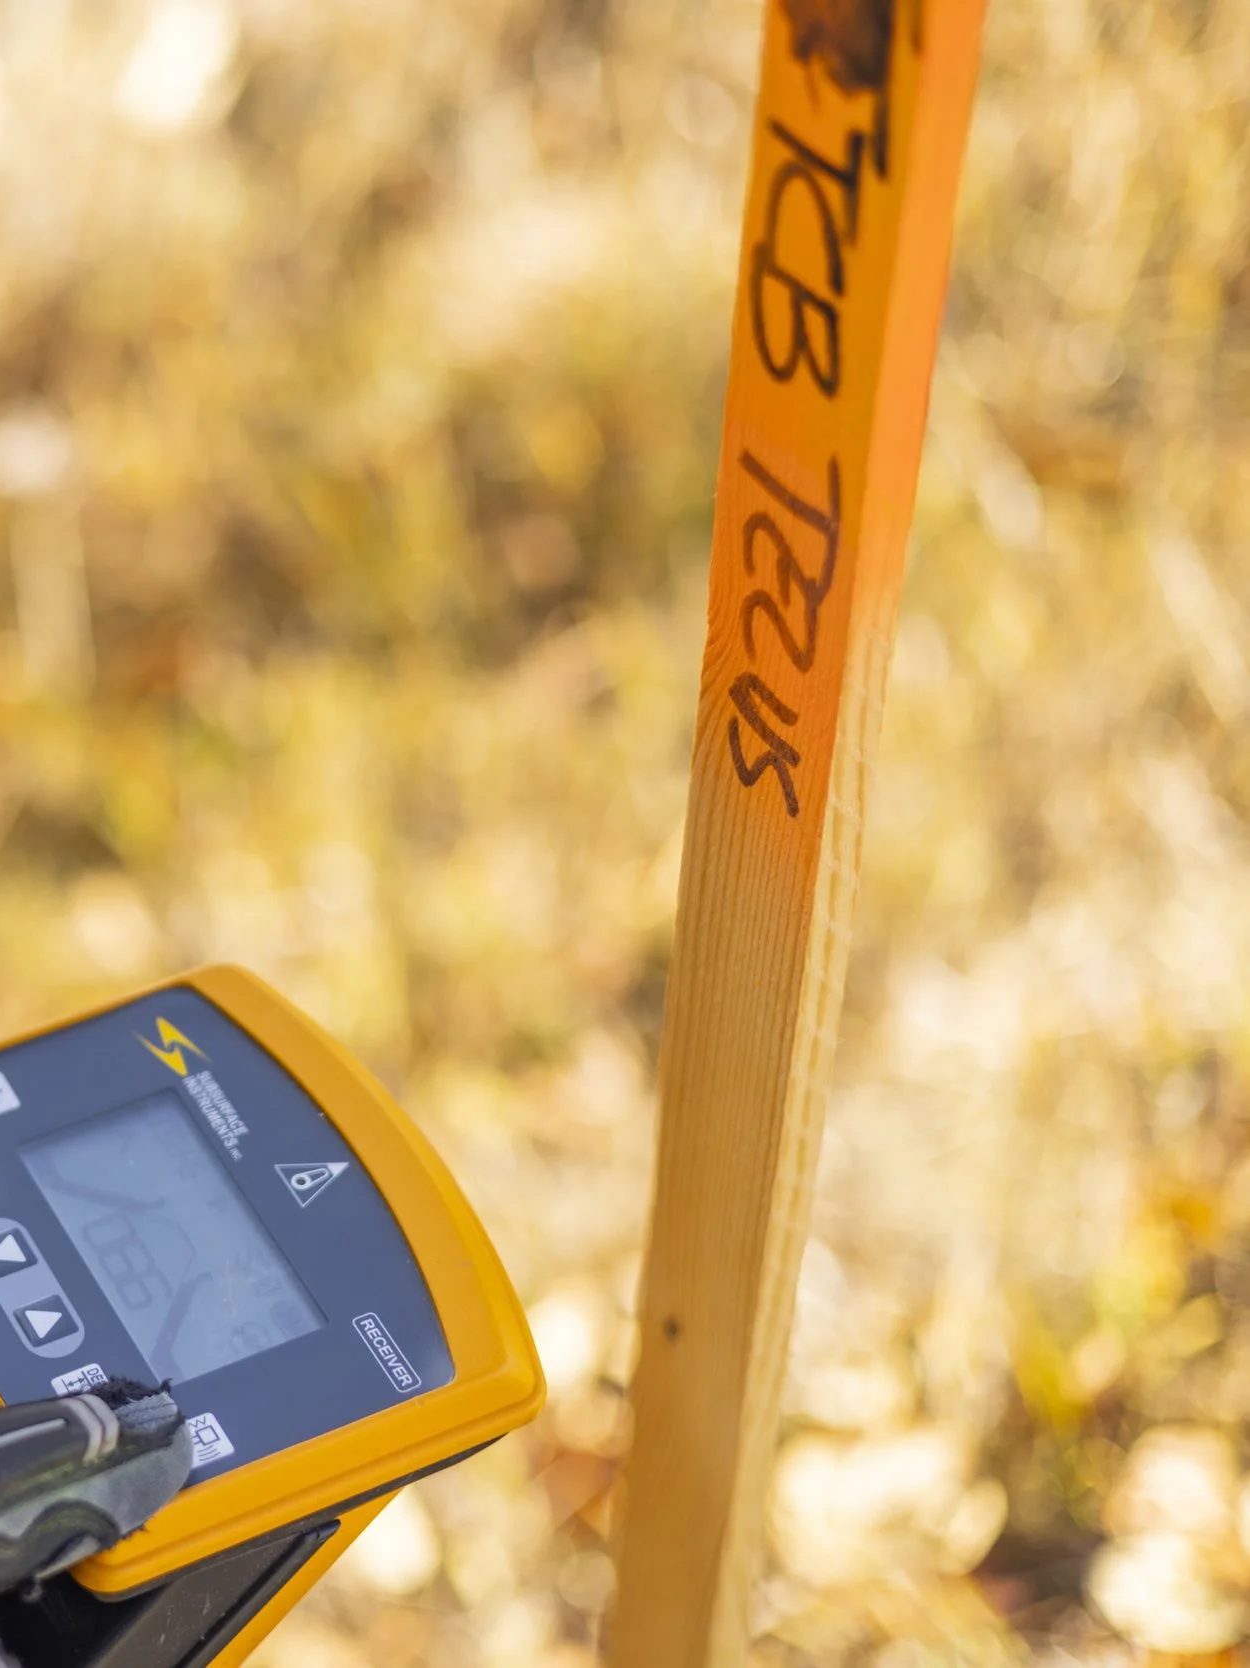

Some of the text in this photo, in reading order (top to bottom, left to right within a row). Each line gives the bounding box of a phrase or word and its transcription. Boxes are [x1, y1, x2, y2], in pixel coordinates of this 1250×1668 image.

[750, 118, 860, 400] TCB
[196, 1070, 249, 1136] SUBSURFACE
[359, 1318, 412, 1387] RECEIVER
